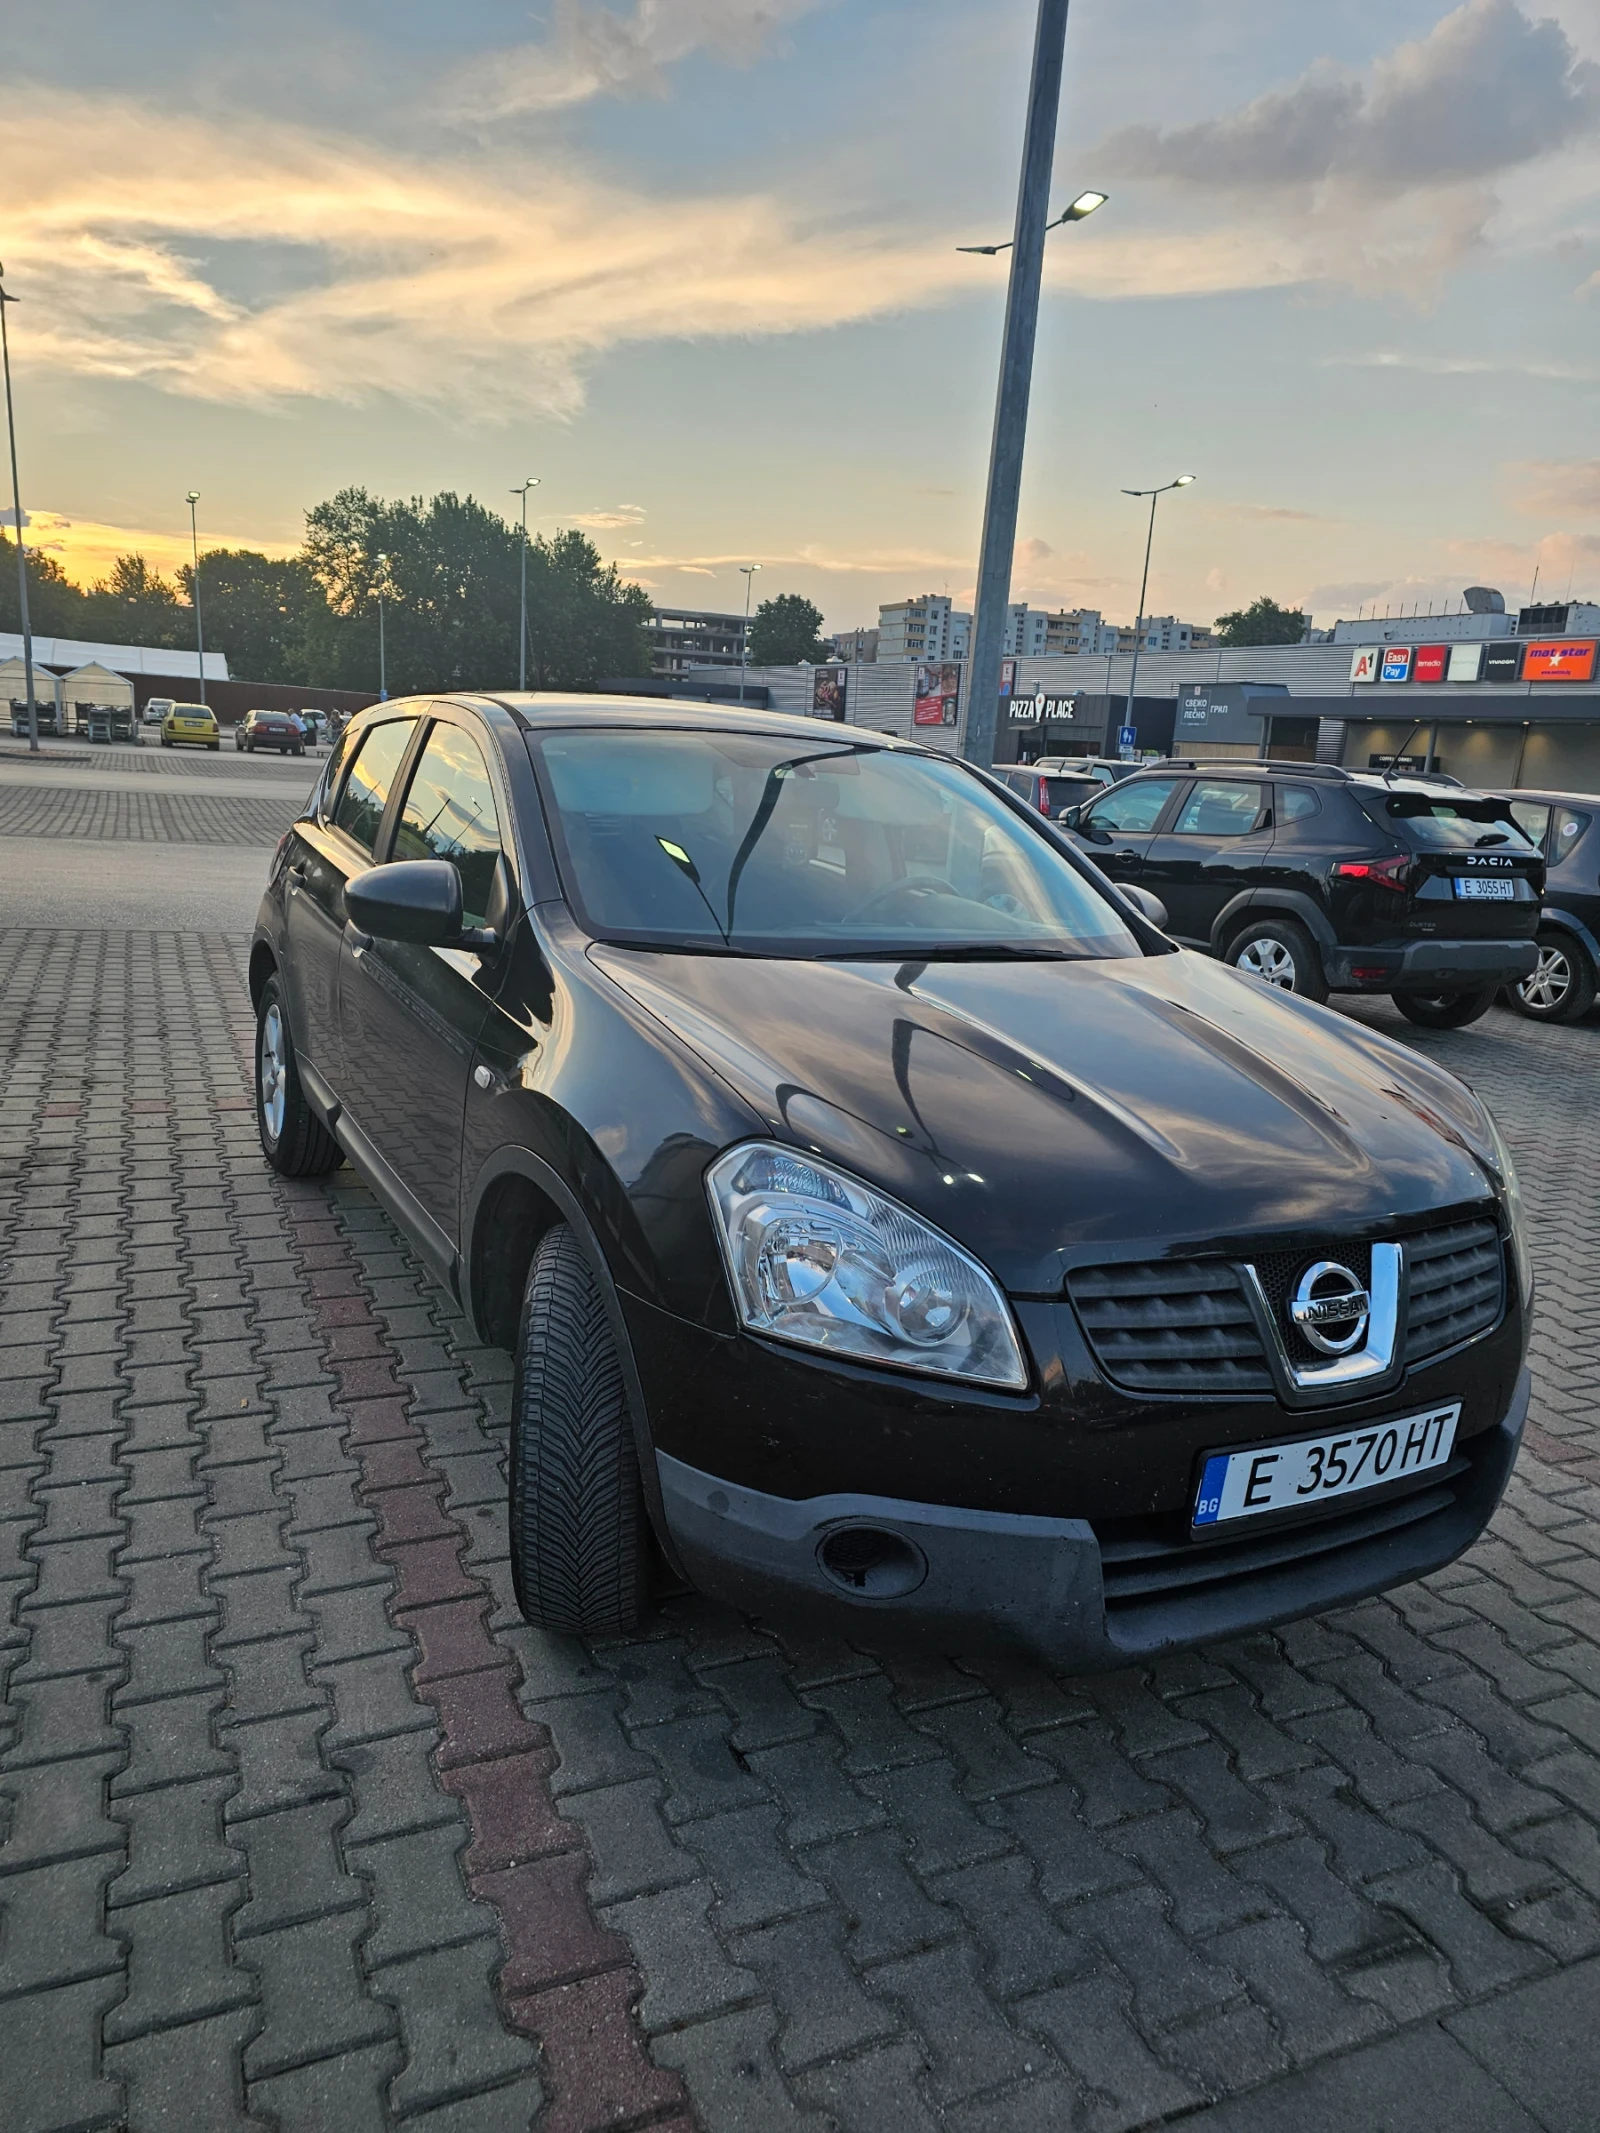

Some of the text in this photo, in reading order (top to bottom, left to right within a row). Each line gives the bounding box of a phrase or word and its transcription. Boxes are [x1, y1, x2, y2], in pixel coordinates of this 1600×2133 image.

[1387, 652, 1407, 663] Easy
[1354, 653, 1374, 677] A1
[1385, 666, 1401, 677] Pay
[1009, 700, 1075, 718] PIZZA PLACE
[1185, 699, 1208, 707] СВЕЖО
[1210, 705, 1228, 713] ГРИЛ
[1184, 711, 1206, 719] ЛЕСНО
[1467, 856, 1513, 867] DACIA
[1464, 880, 1472, 893] E
[1307, 1298, 1368, 1321] NISSAN
[1243, 1454, 1280, 1508] E
[1197, 1497, 1219, 1516] BG
